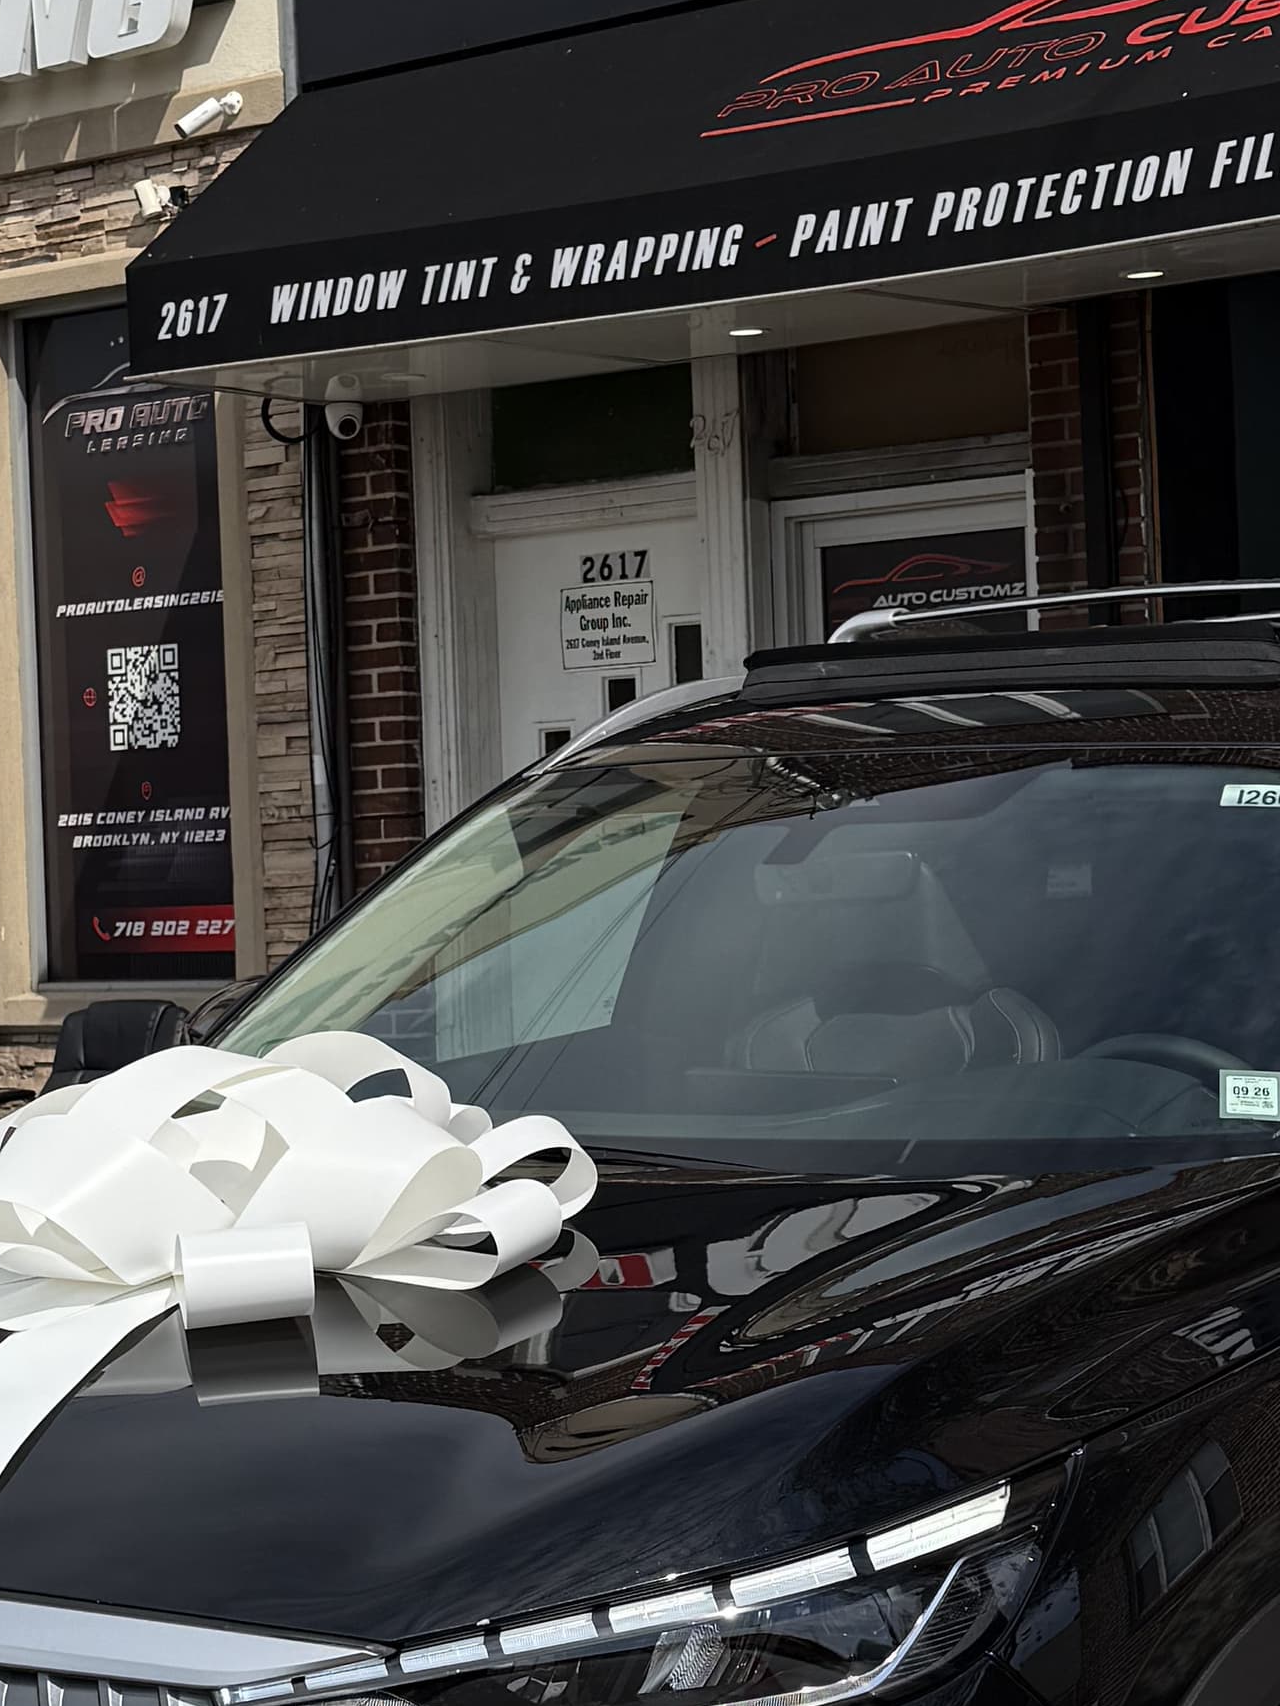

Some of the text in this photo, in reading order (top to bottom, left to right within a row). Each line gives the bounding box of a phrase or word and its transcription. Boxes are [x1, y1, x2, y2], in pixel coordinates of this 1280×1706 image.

[717, 70, 880, 118] PRO
[884, 30, 1107, 91] AUTO
[923, 44, 1173, 104] PREMIUM
[157, 292, 229, 341] 2617
[269, 268, 408, 324] WINDOW
[420, 256, 499, 305] TINT
[511, 252, 532, 295] &
[550, 223, 745, 290] WRAPPING
[789, 197, 914, 258] PAINT
[928, 147, 1194, 236] PROTECTION
[65, 394, 210, 437] PRO AUTO
[87, 428, 188, 454] LEASING
[582, 550, 648, 583] 2617
[56, 590, 224, 617] PROAUTOLEASING2615
[564, 589, 648, 614] Appliance Repair
[872, 582, 1025, 608] AUTO CUSTOMZ
[580, 613, 631, 632] Group Inc.
[58, 806, 231, 827] 2615 CONEY ISLAND AV
[72, 829, 226, 848] BROOKLYN, NY 11223
[113, 919, 236, 937] 718 902 227
